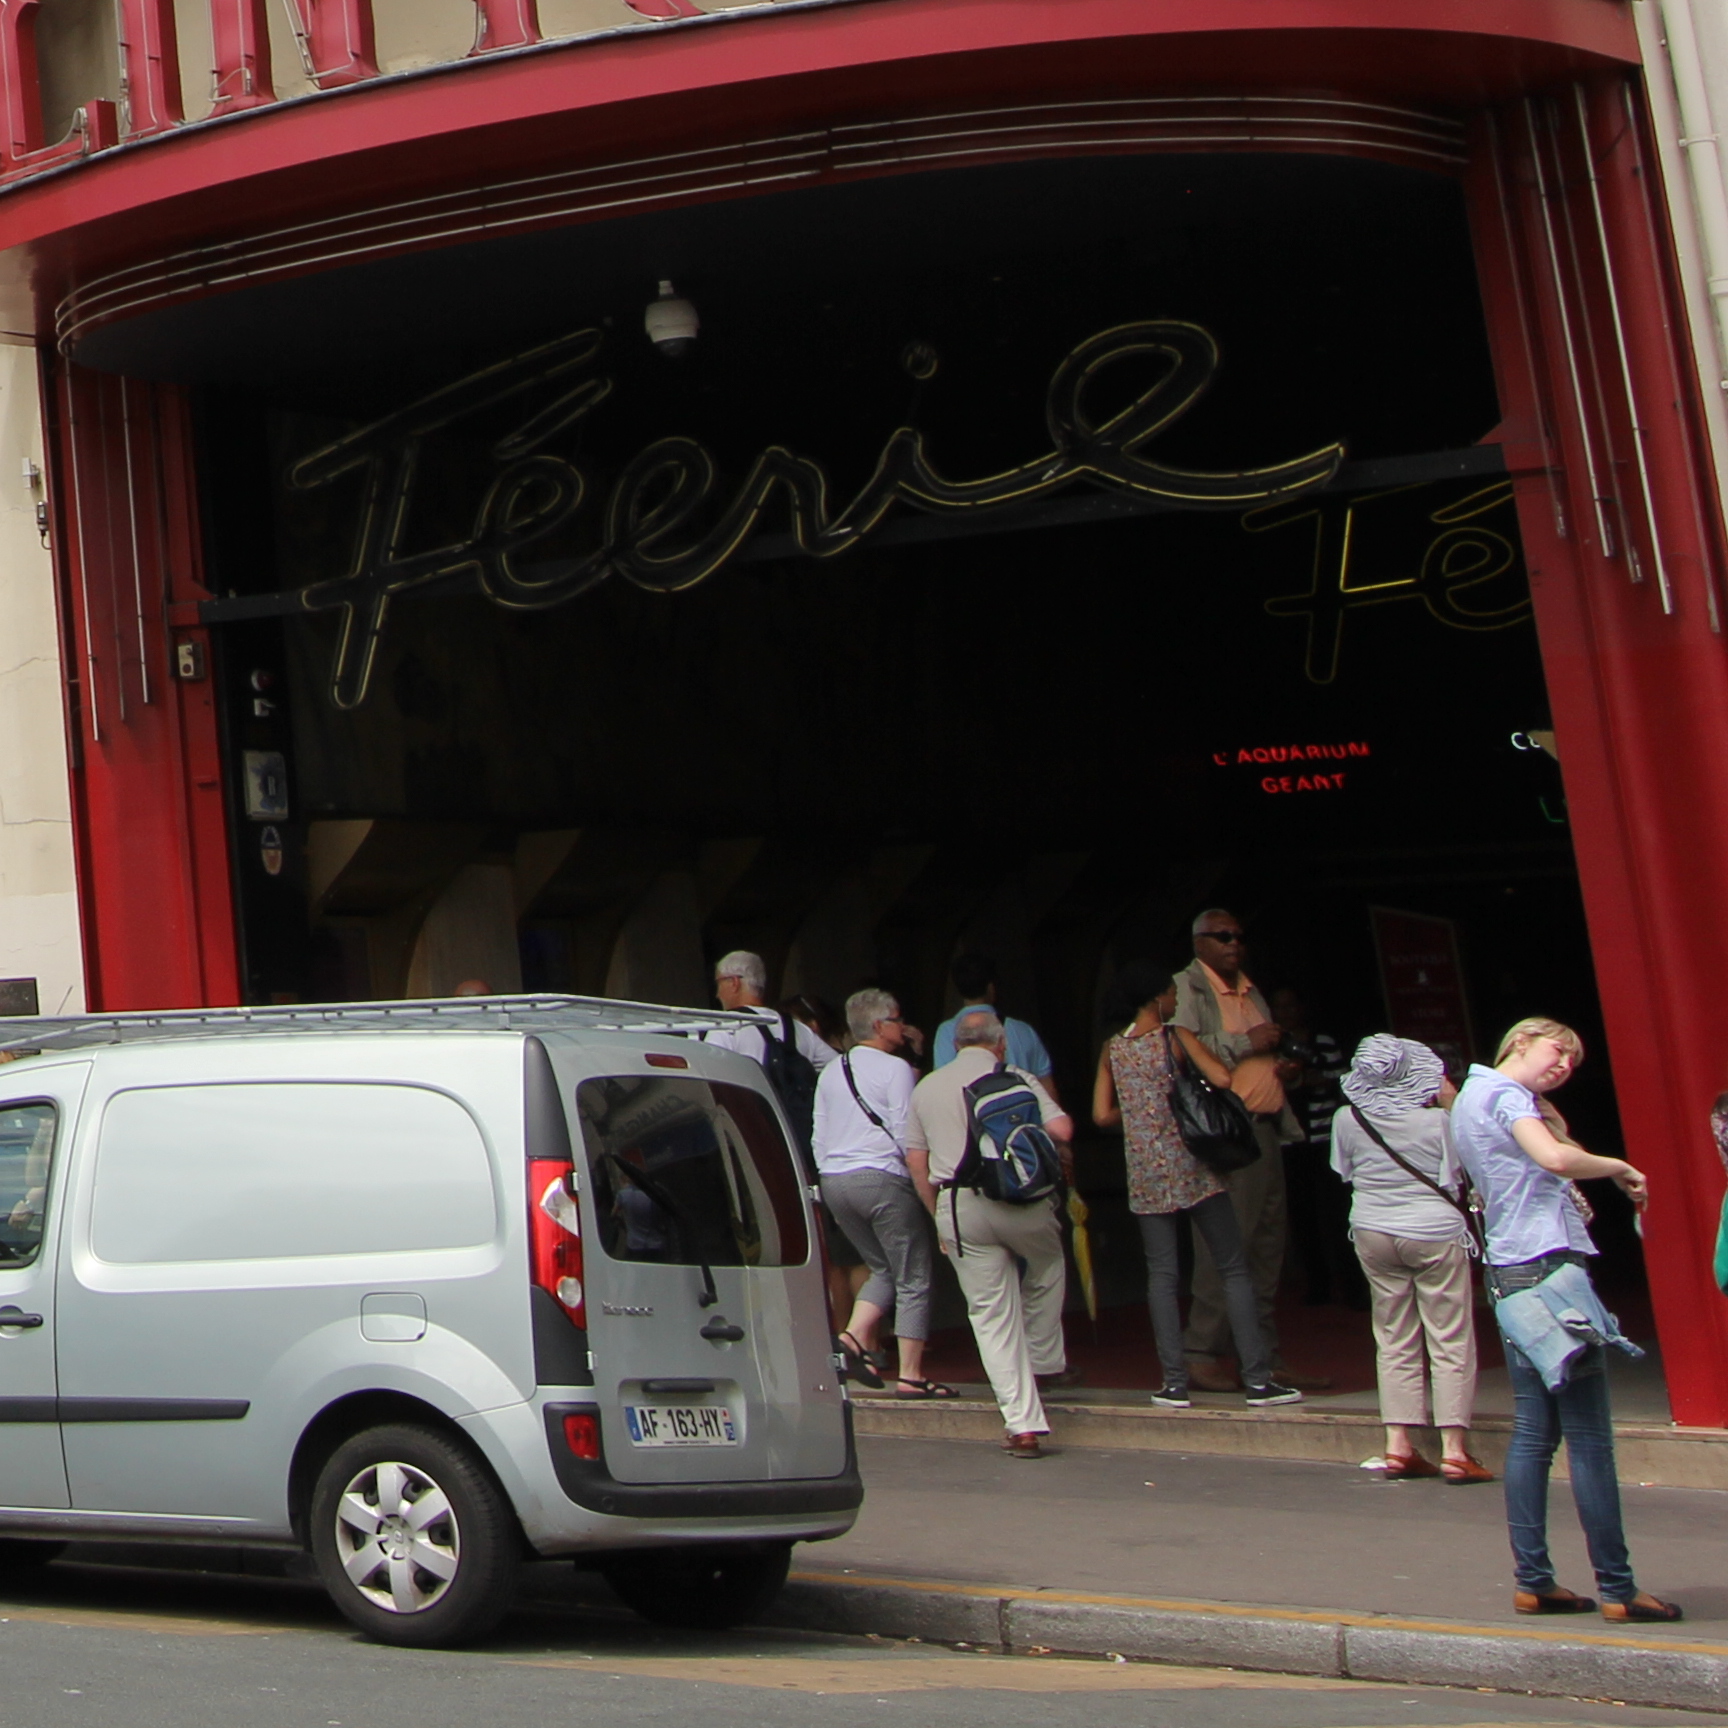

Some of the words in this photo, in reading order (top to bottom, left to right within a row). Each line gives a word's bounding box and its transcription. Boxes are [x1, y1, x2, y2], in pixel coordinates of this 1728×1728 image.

[1236, 741, 1371, 764] AQUARIUM
[1261, 774, 1347, 794] GEANT
[639, 1408, 722, 1438] AF-163-HY
